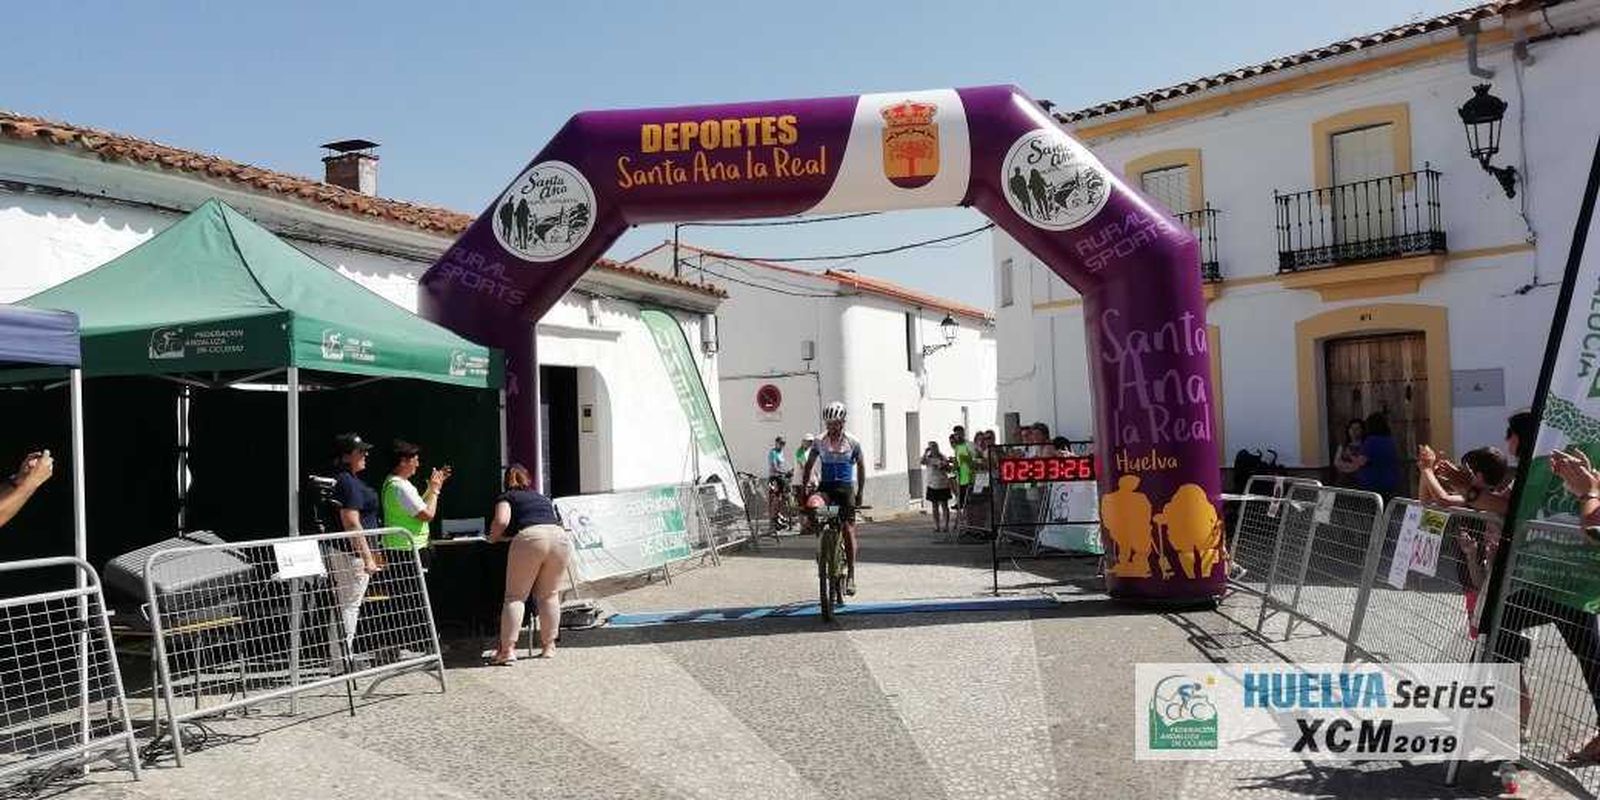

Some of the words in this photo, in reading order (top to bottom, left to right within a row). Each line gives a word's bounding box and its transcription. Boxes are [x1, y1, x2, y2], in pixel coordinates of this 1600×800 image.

[641, 115, 799, 154] DEPORTES
[520, 172, 565, 195] Santa
[617, 155, 687, 189] Santa
[693, 151, 740, 183] Ana
[747, 147, 769, 179] la
[773, 146, 827, 176] Real
[1101, 308, 1207, 364] Santa
[1118, 347, 1207, 411] Ana
[1113, 409, 1141, 447] la
[1149, 402, 1212, 445] Real
[1002, 459, 1091, 481] 02:33:26
[1115, 449, 1179, 474] Huelva
